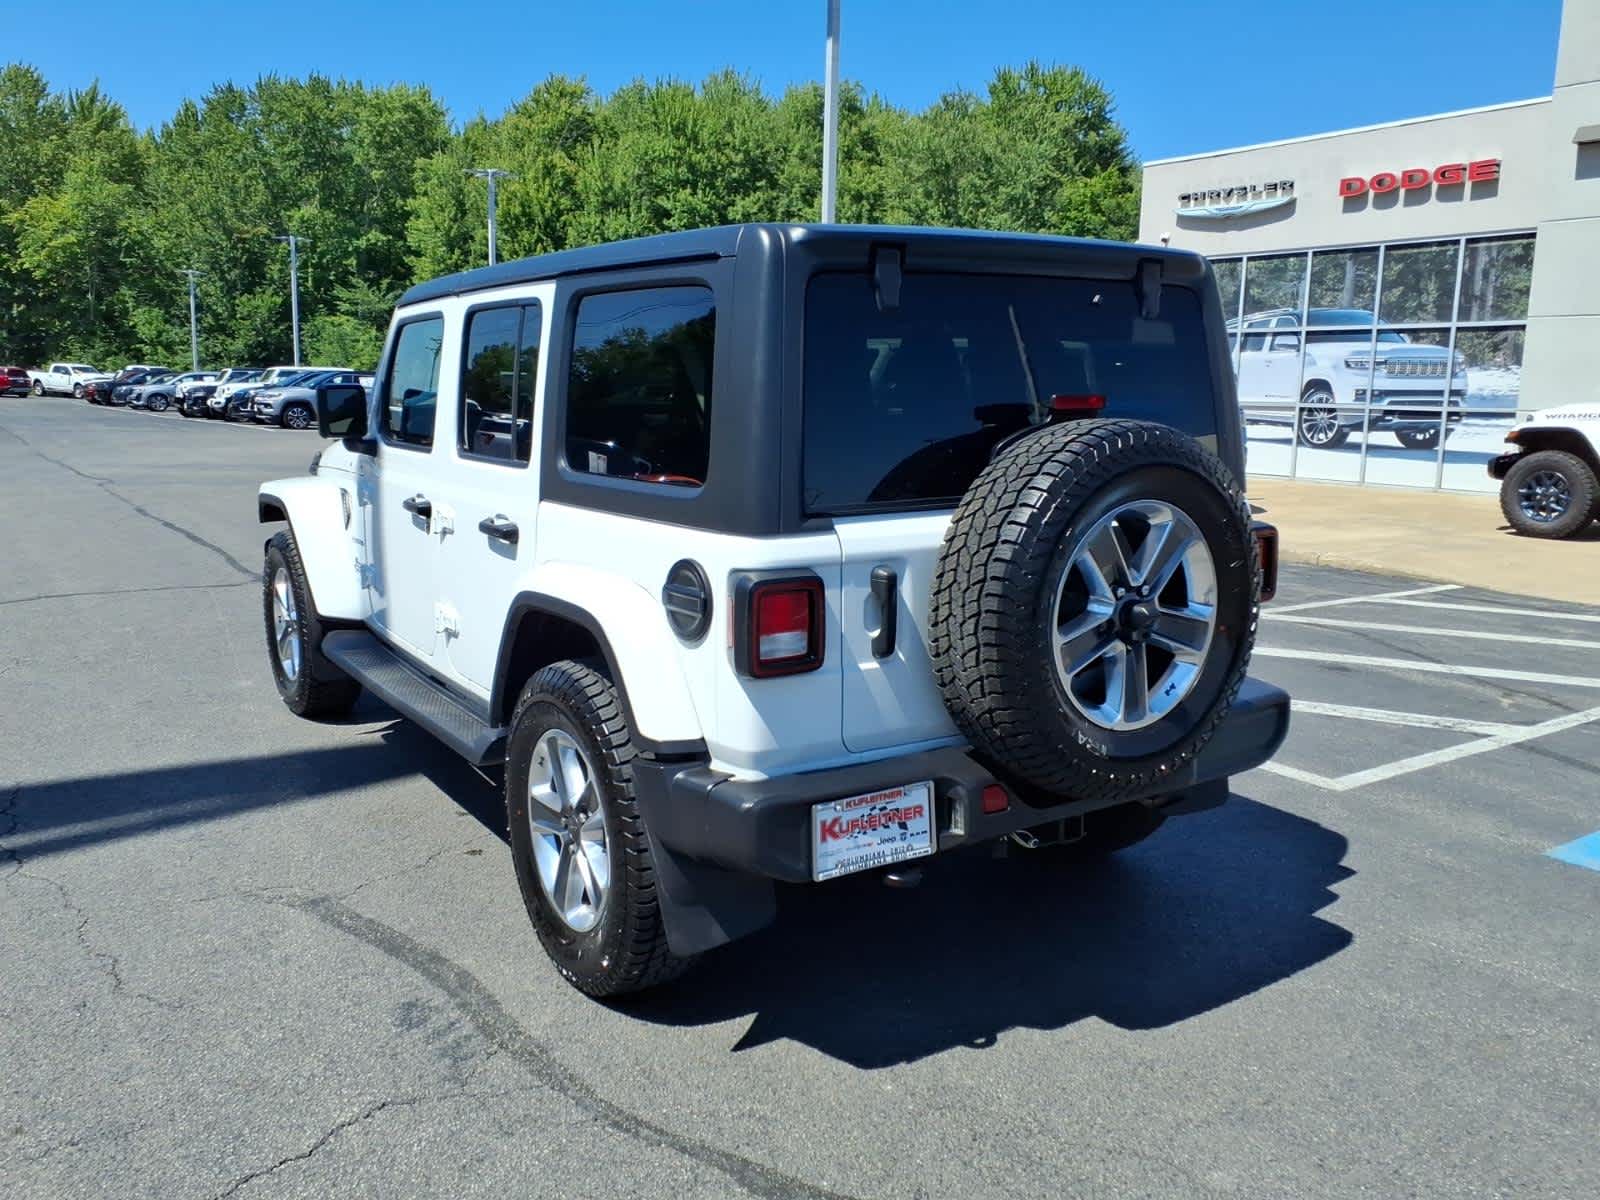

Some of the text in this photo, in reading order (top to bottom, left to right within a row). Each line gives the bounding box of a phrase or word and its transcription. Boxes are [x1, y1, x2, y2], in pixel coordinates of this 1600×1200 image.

[1178, 180, 1295, 203] CHRYSLER
[1339, 158, 1501, 197] DODGE
[821, 805, 924, 843] KUFLEITNER
